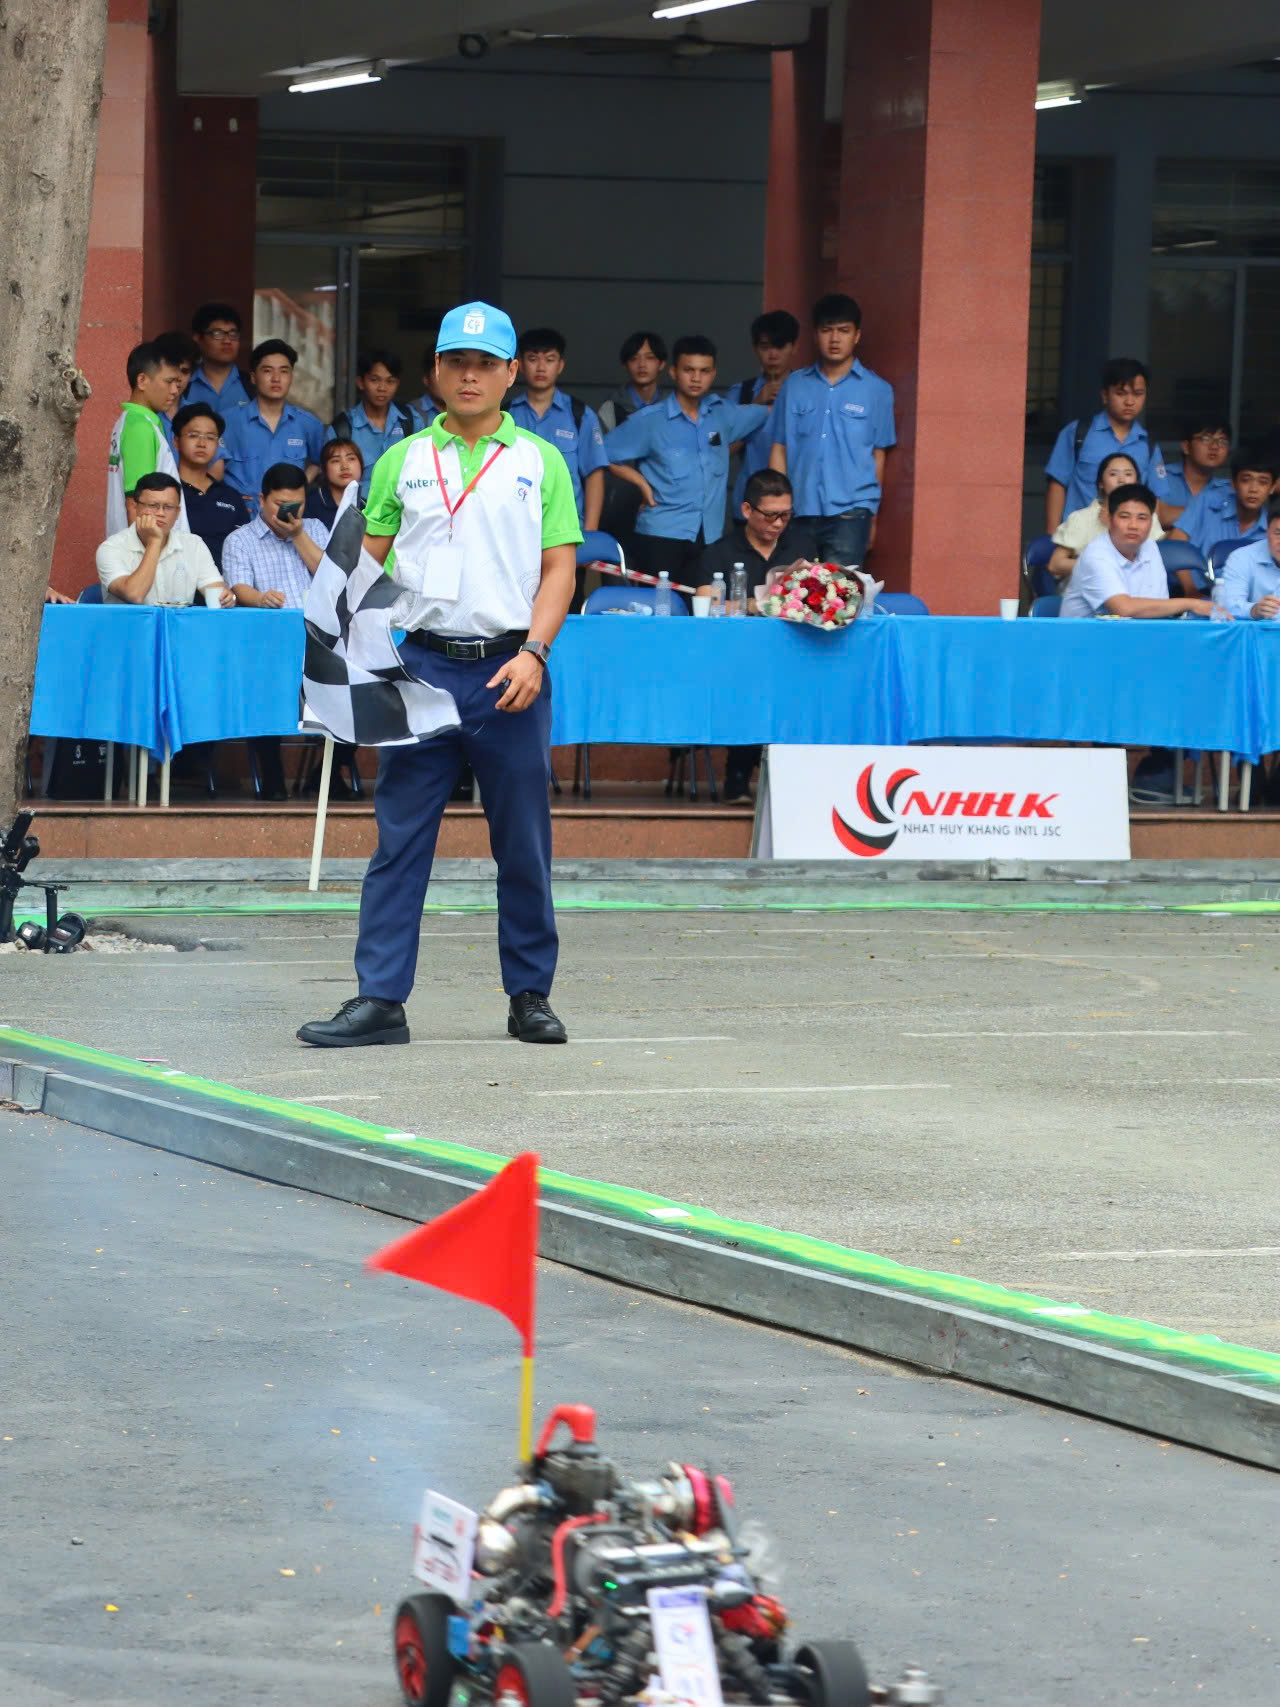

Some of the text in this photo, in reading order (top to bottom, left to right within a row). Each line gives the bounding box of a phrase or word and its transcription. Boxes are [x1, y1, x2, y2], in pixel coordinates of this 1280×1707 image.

[901, 791, 1061, 818] NHHK
[903, 823, 1062, 837] NHAT HUY KHANG INTL JSC
